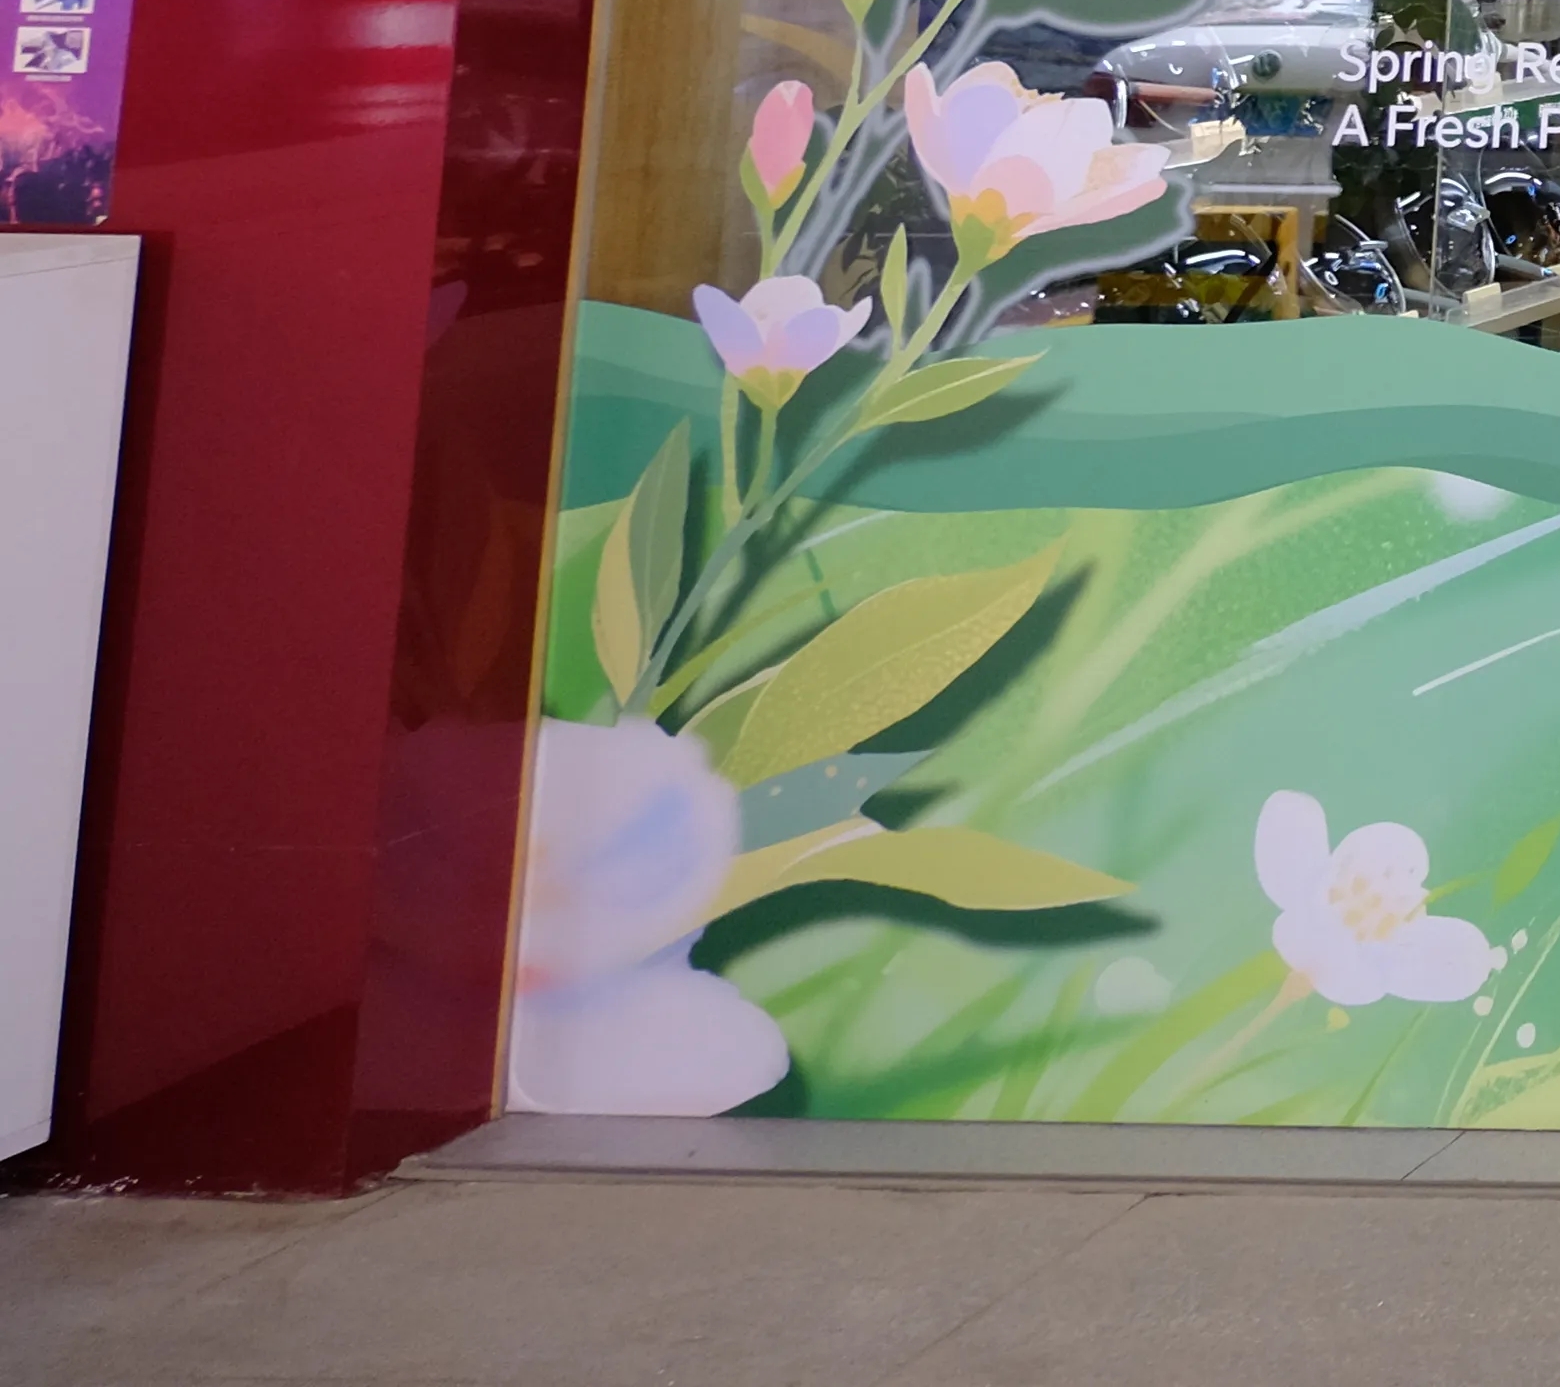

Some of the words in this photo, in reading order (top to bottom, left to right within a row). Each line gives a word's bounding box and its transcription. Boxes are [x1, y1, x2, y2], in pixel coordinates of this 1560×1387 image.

[1336, 40, 1500, 95] Spring
[1332, 107, 1369, 147] A
[1385, 103, 1524, 150] Fresh
